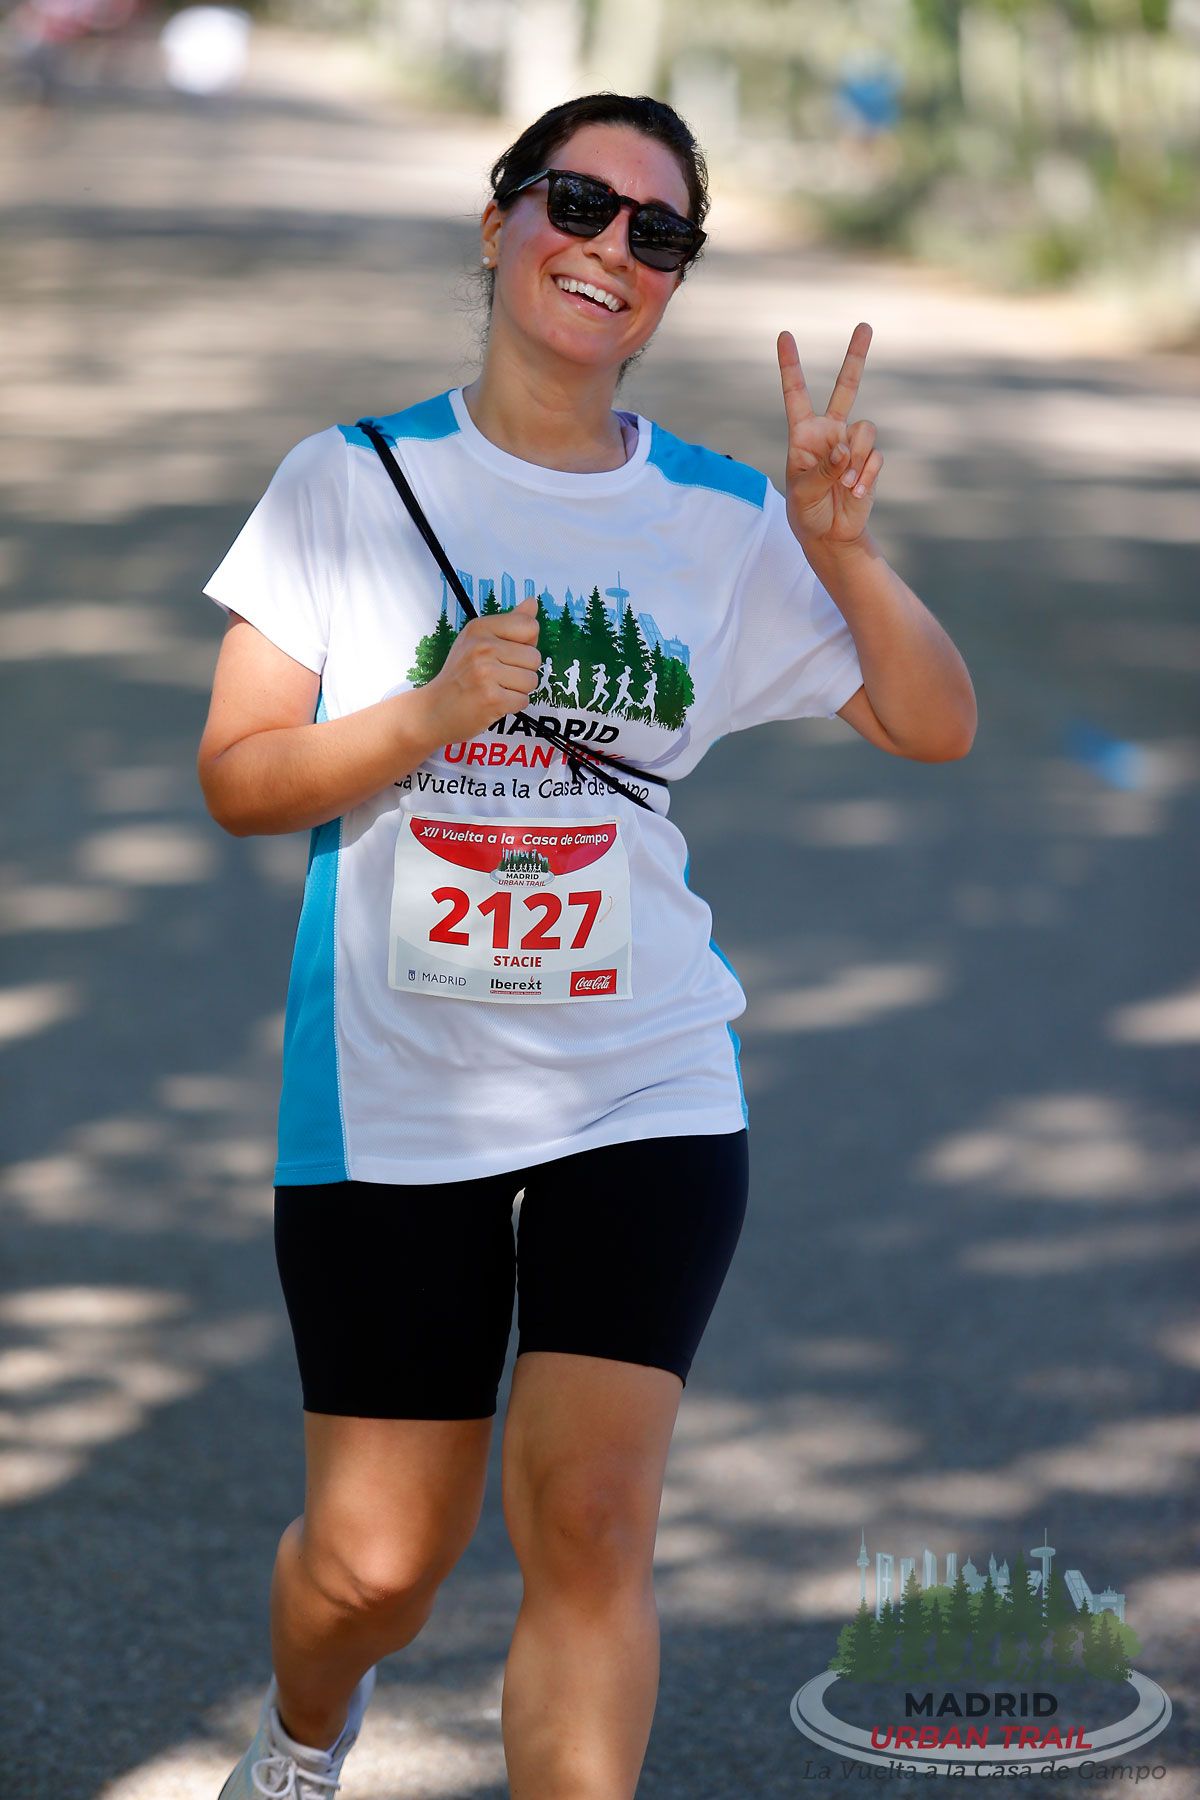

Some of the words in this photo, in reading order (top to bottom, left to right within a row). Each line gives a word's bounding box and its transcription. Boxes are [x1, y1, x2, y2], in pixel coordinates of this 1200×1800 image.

[444, 741, 555, 769] URBAN
[394, 774, 412, 790] a
[416, 771, 487, 798] Vuelta
[492, 781, 506, 798] a
[512, 778, 531, 799] la
[539, 778, 582, 799] Casa
[588, 776, 604, 797] de
[420, 826, 440, 838] XII
[441, 827, 484, 844] Vuelta
[487, 834, 498, 844] a
[501, 832, 515, 845] la
[522, 833, 557, 846] Casa
[560, 833, 573, 846] de
[574, 832, 609, 846] Campo
[506, 872, 540, 880] MADRID
[429, 886, 602, 950] 2127
[493, 955, 542, 968] STACIE
[421, 971, 467, 987] MADRID
[490, 978, 542, 990] Iberext
